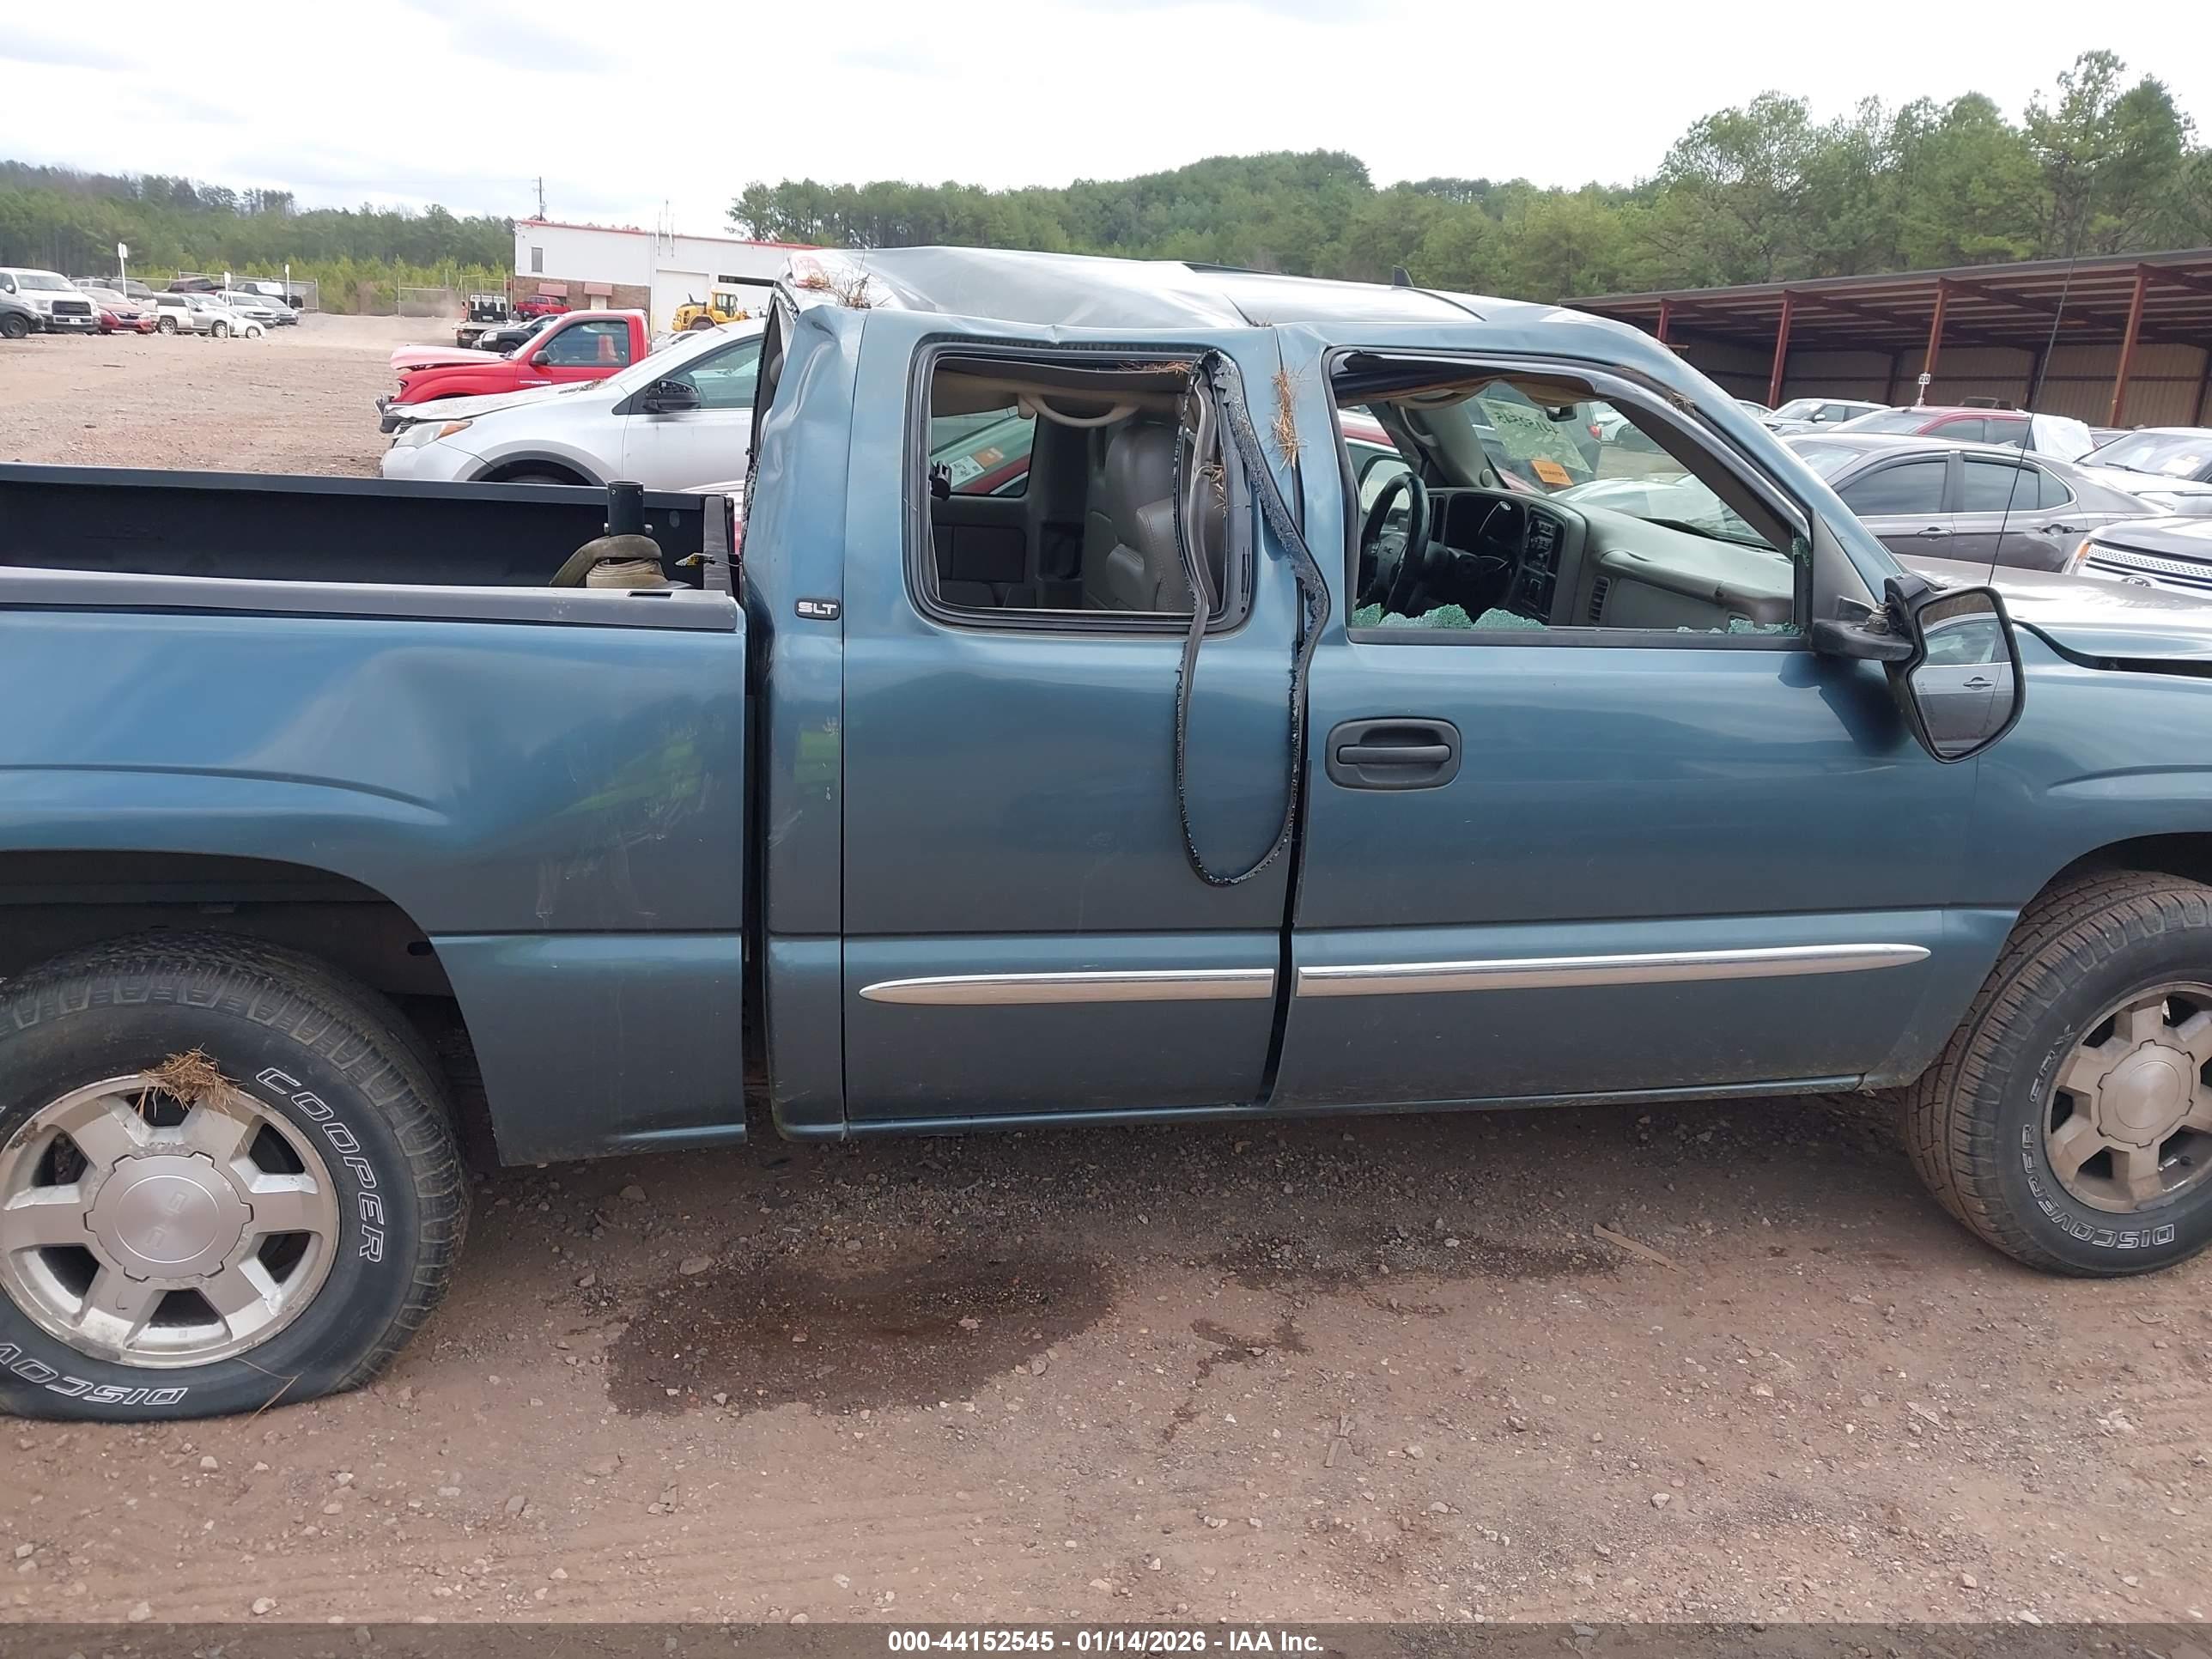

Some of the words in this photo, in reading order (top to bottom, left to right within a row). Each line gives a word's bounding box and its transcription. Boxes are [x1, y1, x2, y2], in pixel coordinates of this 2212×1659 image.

[798, 601, 837, 615] SLT
[255, 1067, 386, 1263] COOPER
[2021, 1123, 2175, 1249] DISCOVERER
